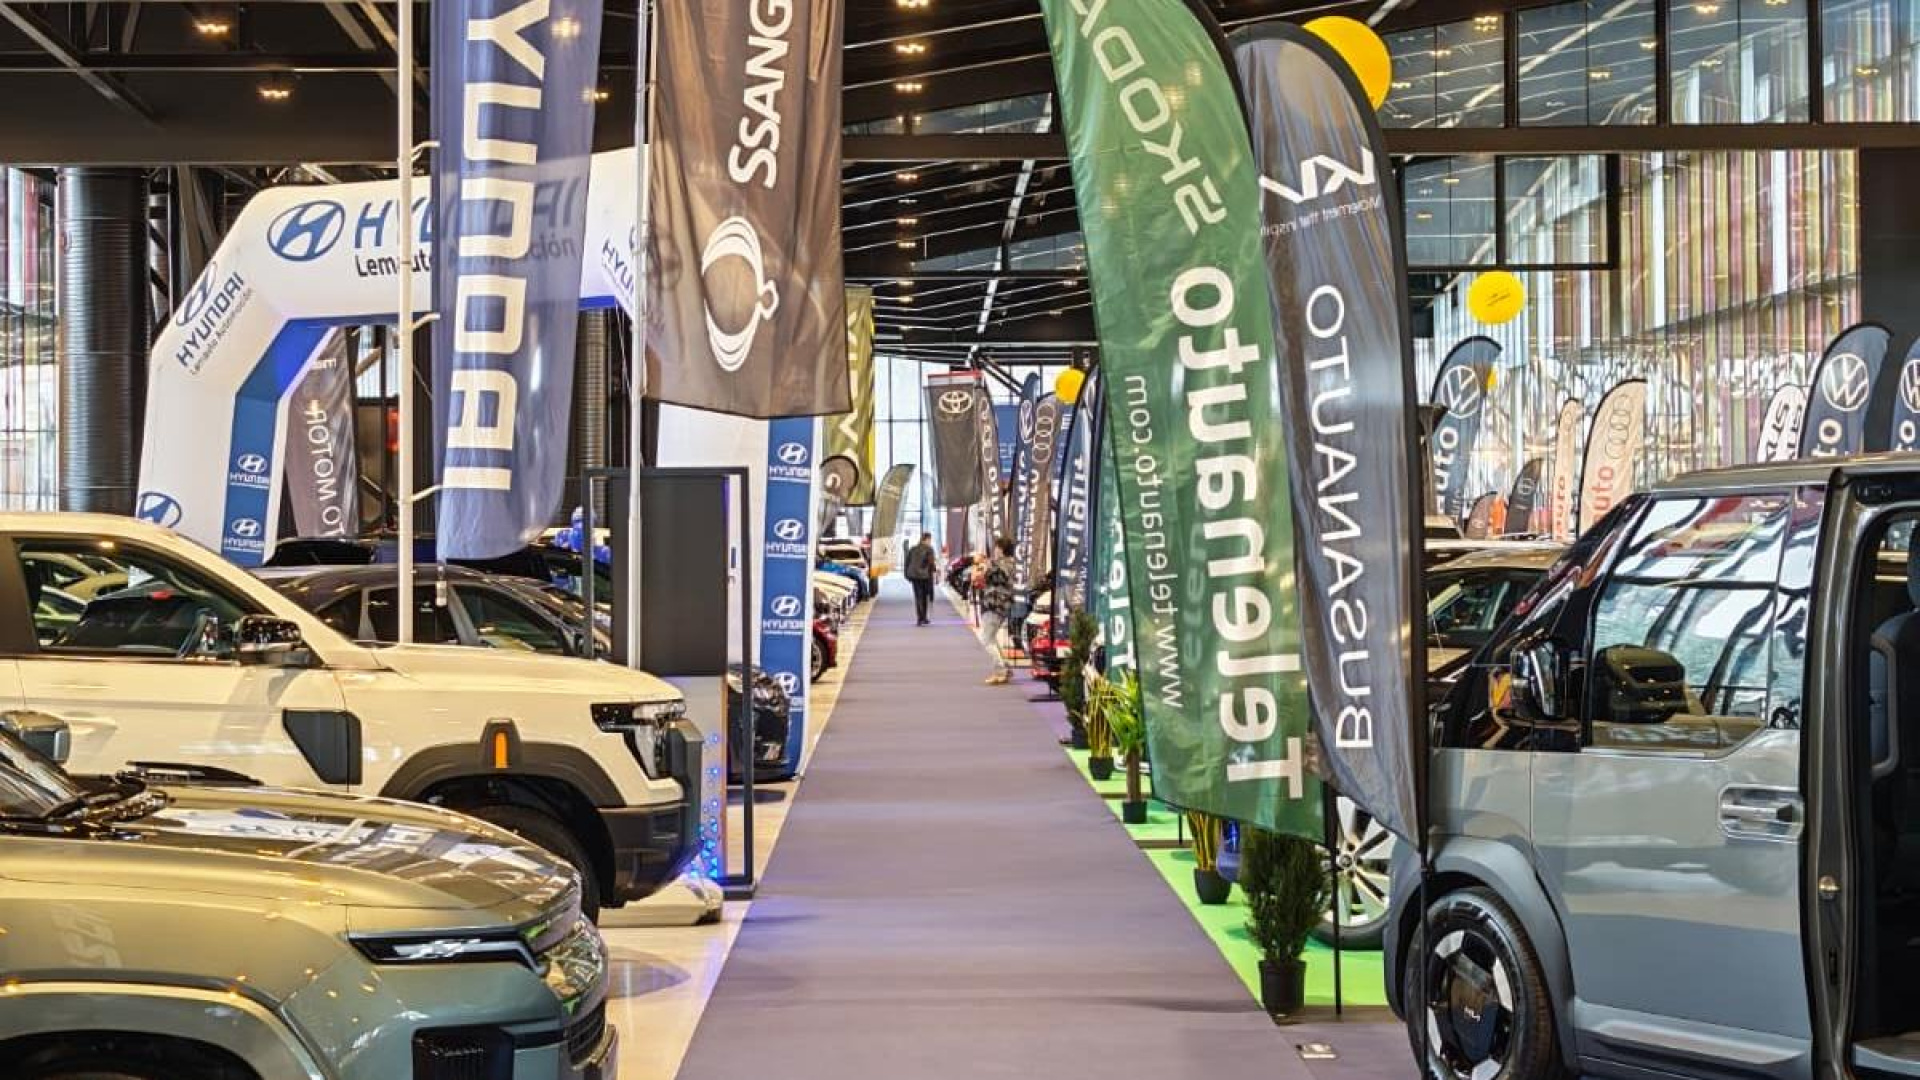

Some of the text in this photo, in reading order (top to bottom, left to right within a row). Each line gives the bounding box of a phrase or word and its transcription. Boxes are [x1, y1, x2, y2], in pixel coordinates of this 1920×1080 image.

[727, 0, 794, 189] SSANG
[354, 246, 435, 278] Lemut
[175, 271, 244, 367] HYUNDAI
